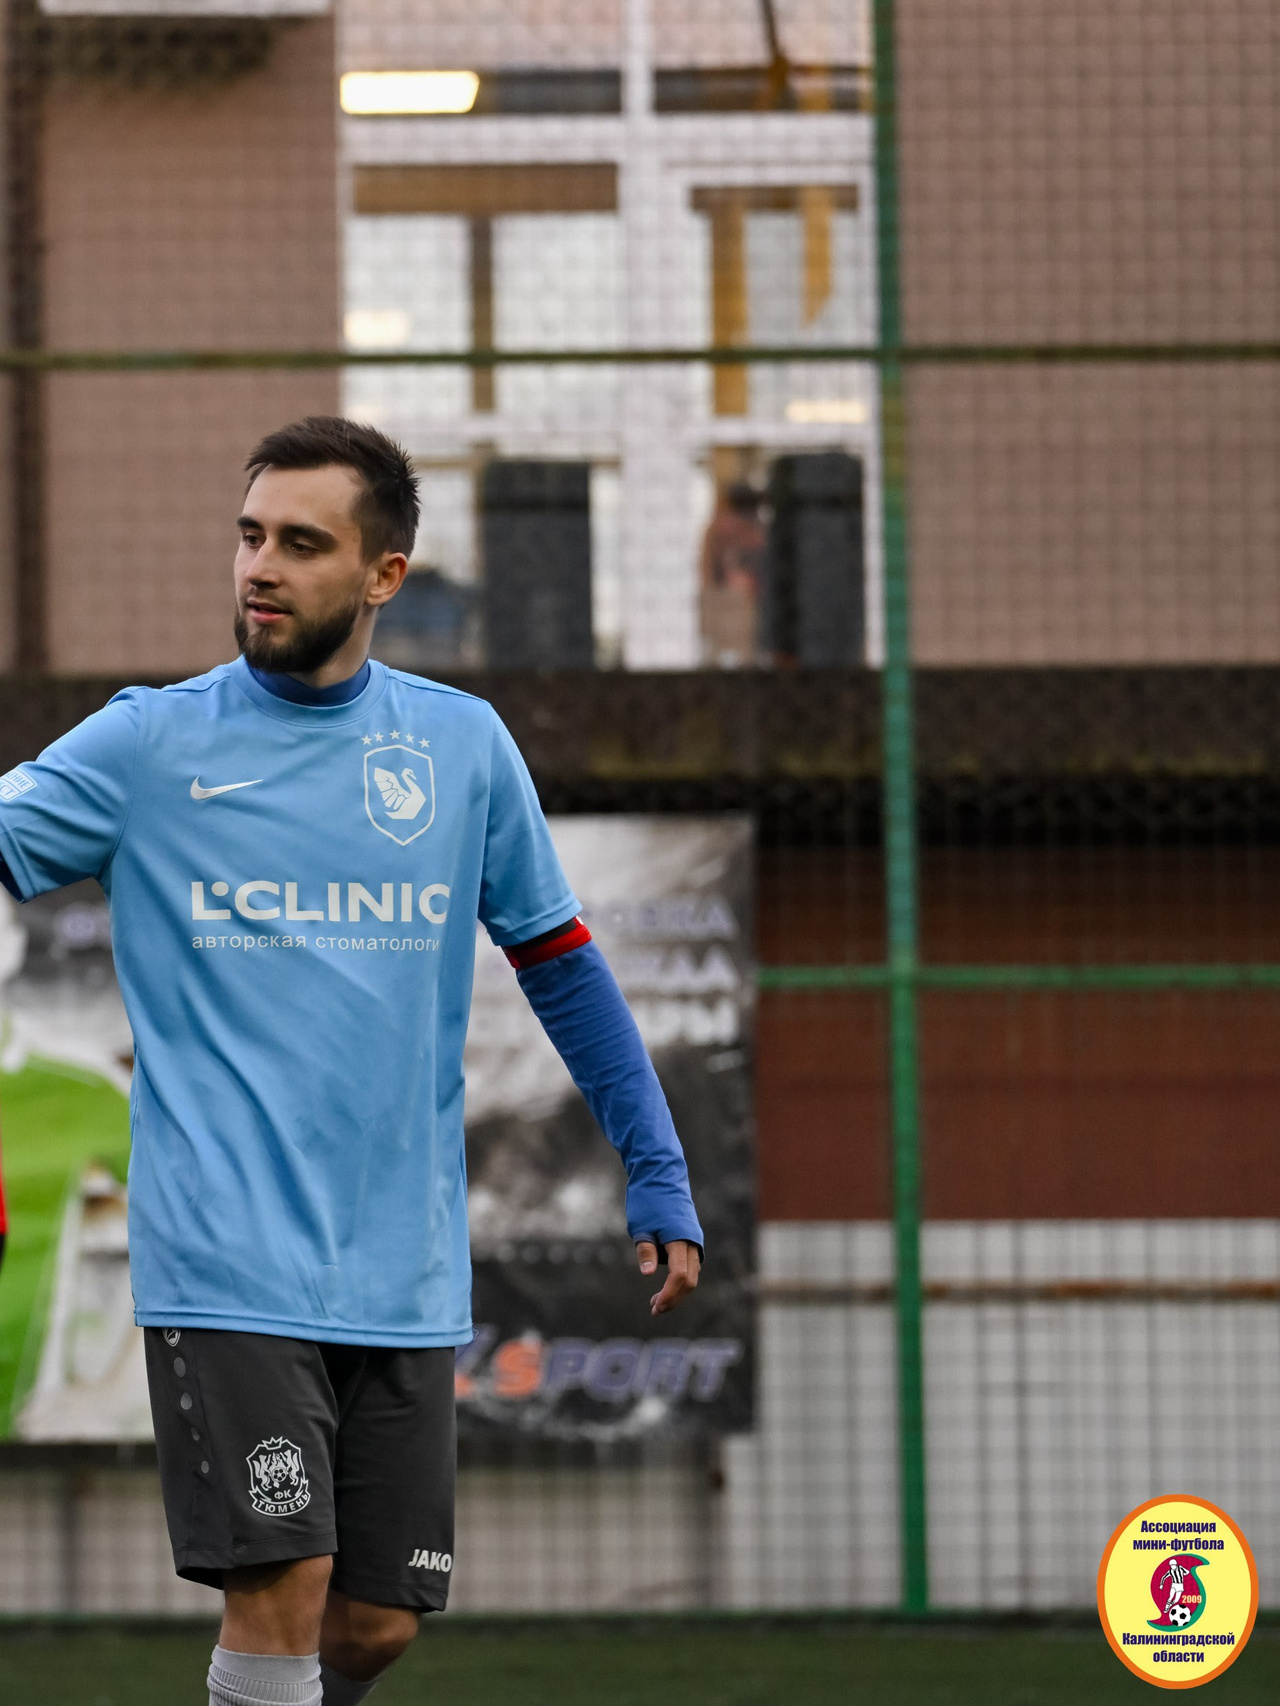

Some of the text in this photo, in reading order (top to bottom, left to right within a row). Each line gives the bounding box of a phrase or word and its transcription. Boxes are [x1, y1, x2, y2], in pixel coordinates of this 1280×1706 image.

[192, 935, 307, 951] авторская
[257, 1493, 309, 1513] ТЮМЕНЬ
[274, 1489, 292, 1499] ФК
[408, 1548, 452, 1573] JAKO
